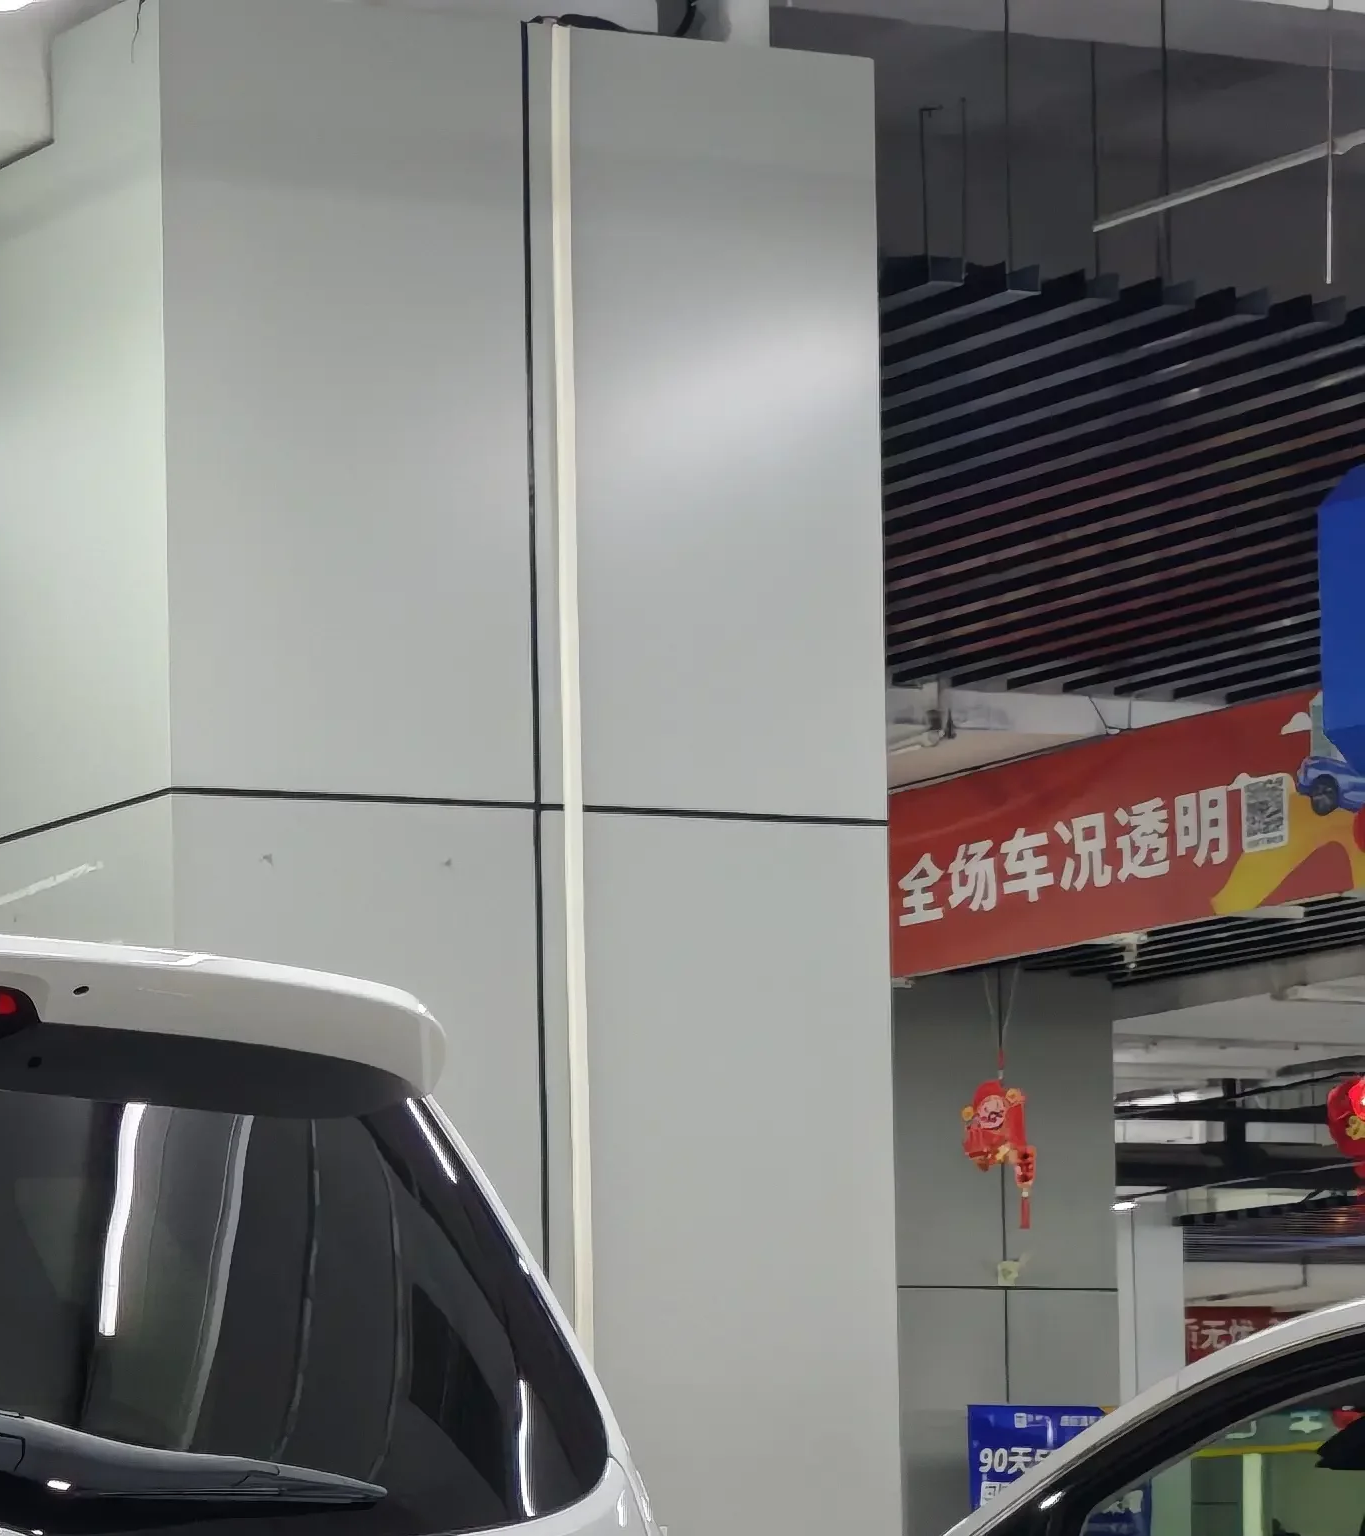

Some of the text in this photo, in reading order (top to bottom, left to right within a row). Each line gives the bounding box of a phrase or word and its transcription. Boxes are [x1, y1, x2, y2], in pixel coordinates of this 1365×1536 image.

[897, 786, 1229, 927] 全场车况透明
